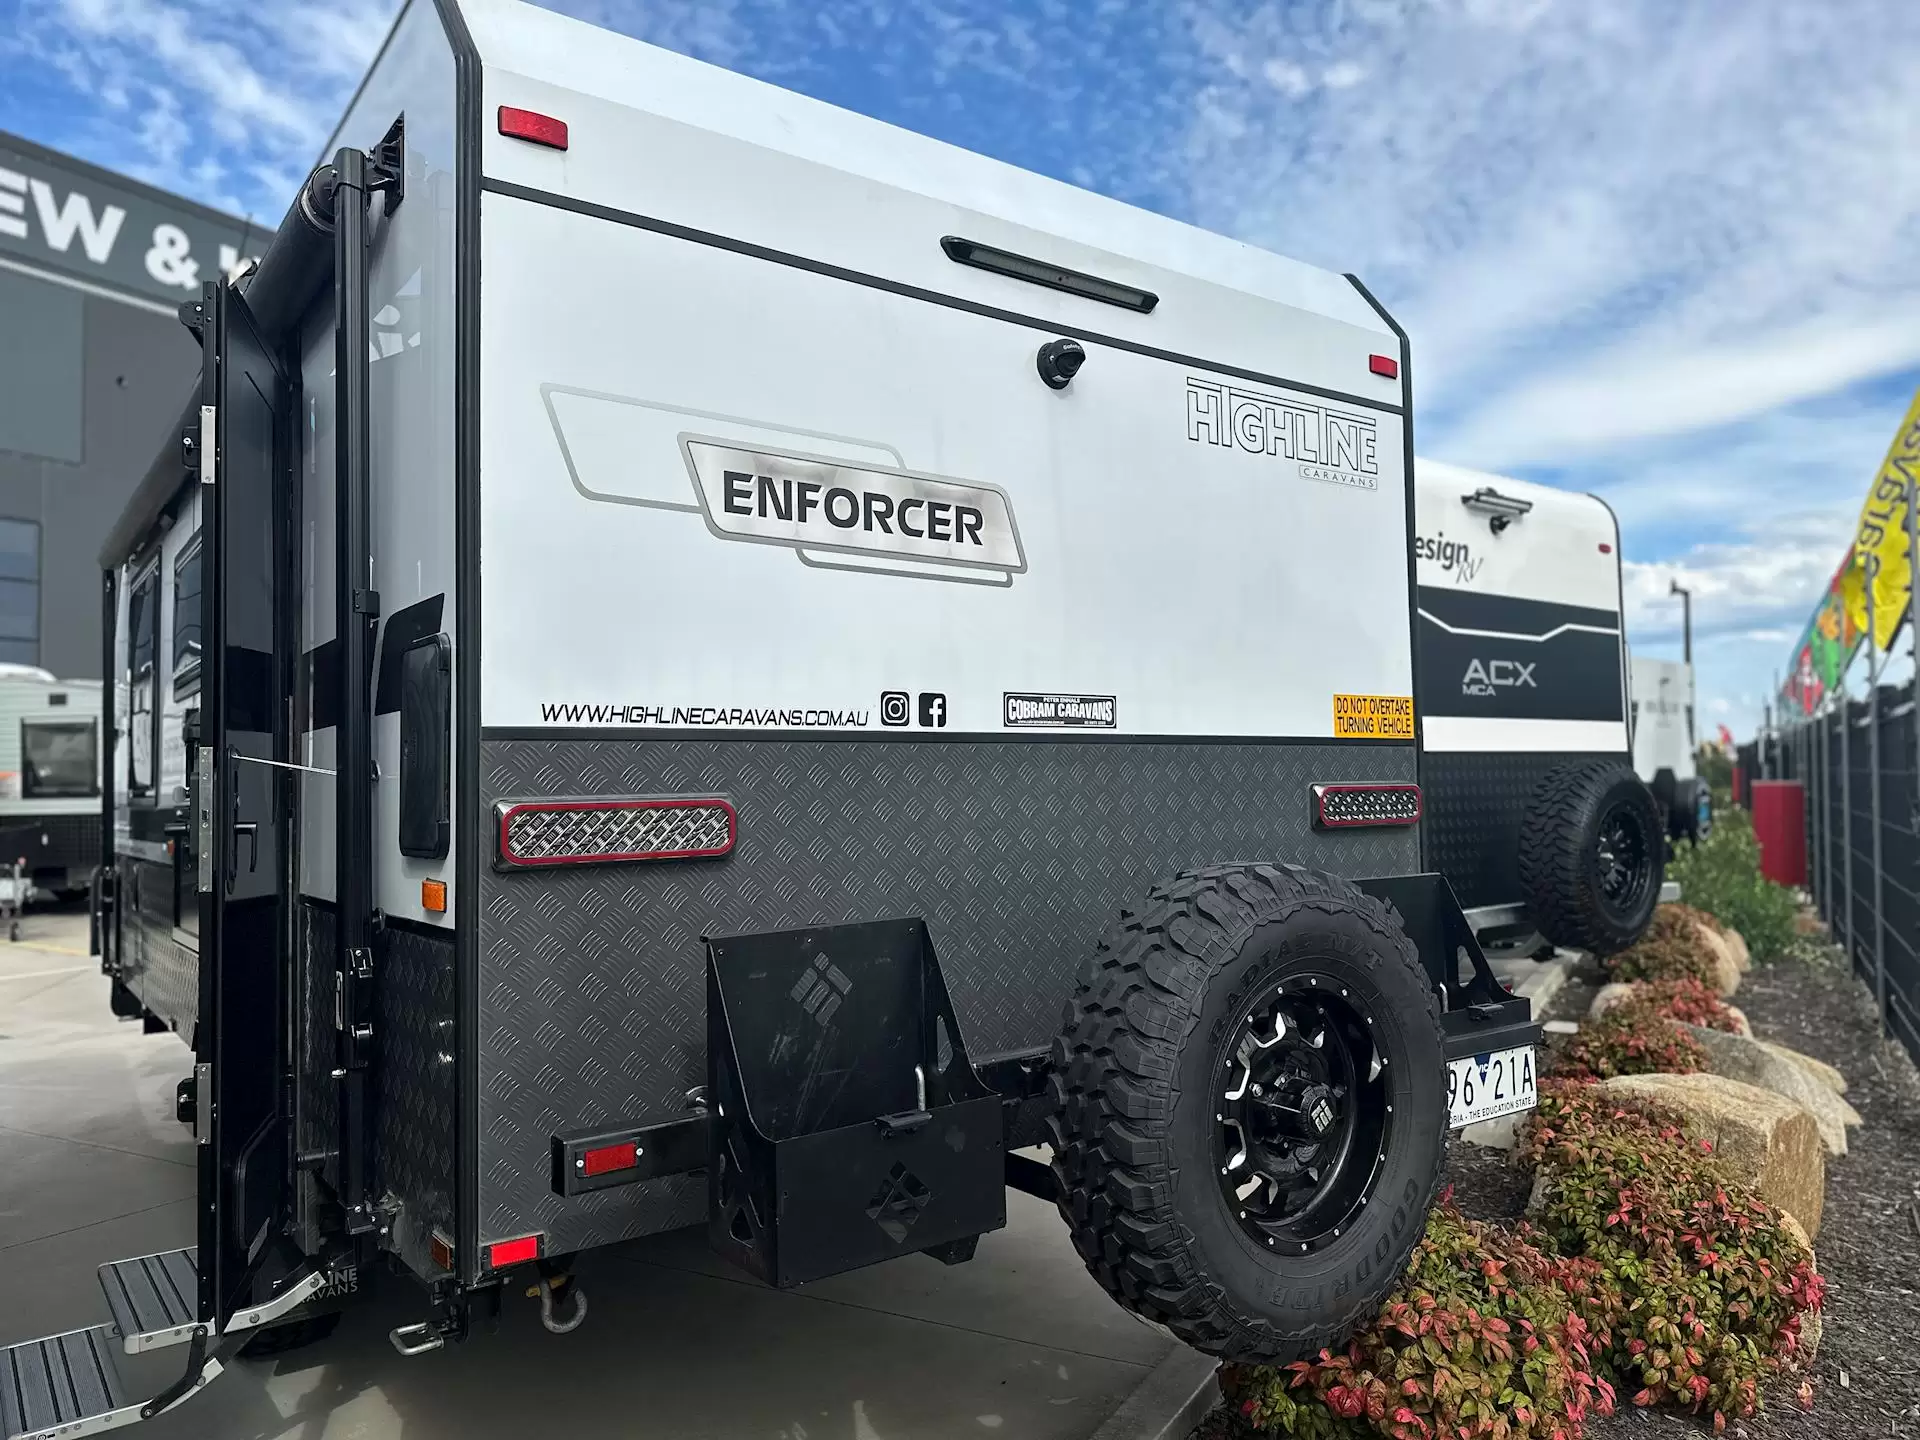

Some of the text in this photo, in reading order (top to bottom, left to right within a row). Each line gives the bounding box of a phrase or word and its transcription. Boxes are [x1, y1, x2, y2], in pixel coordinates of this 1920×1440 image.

[1186, 376, 1379, 475] HIGHLINE
[1303, 467, 1375, 488] CARAVANS
[723, 470, 984, 546] ENFORCER
[1456, 557, 1484, 584] RV
[1463, 658, 1538, 688] ACX
[541, 703, 870, 727] WWW.HIGHLINECARAVANS.COM.AU
[1008, 698, 1113, 722] COBRAM CARAVANS
[1337, 697, 1410, 715] DO NOT OVERTAKE
[1337, 716, 1411, 734] TURNING VEHICLE
[1493, 1053, 1534, 1100] 21A
[1469, 1109, 1481, 1120] THE
[1482, 1102, 1515, 1117] EDUCATION
[1515, 1096, 1532, 1108] STATE
[303, 1281, 358, 1303] AVANS
